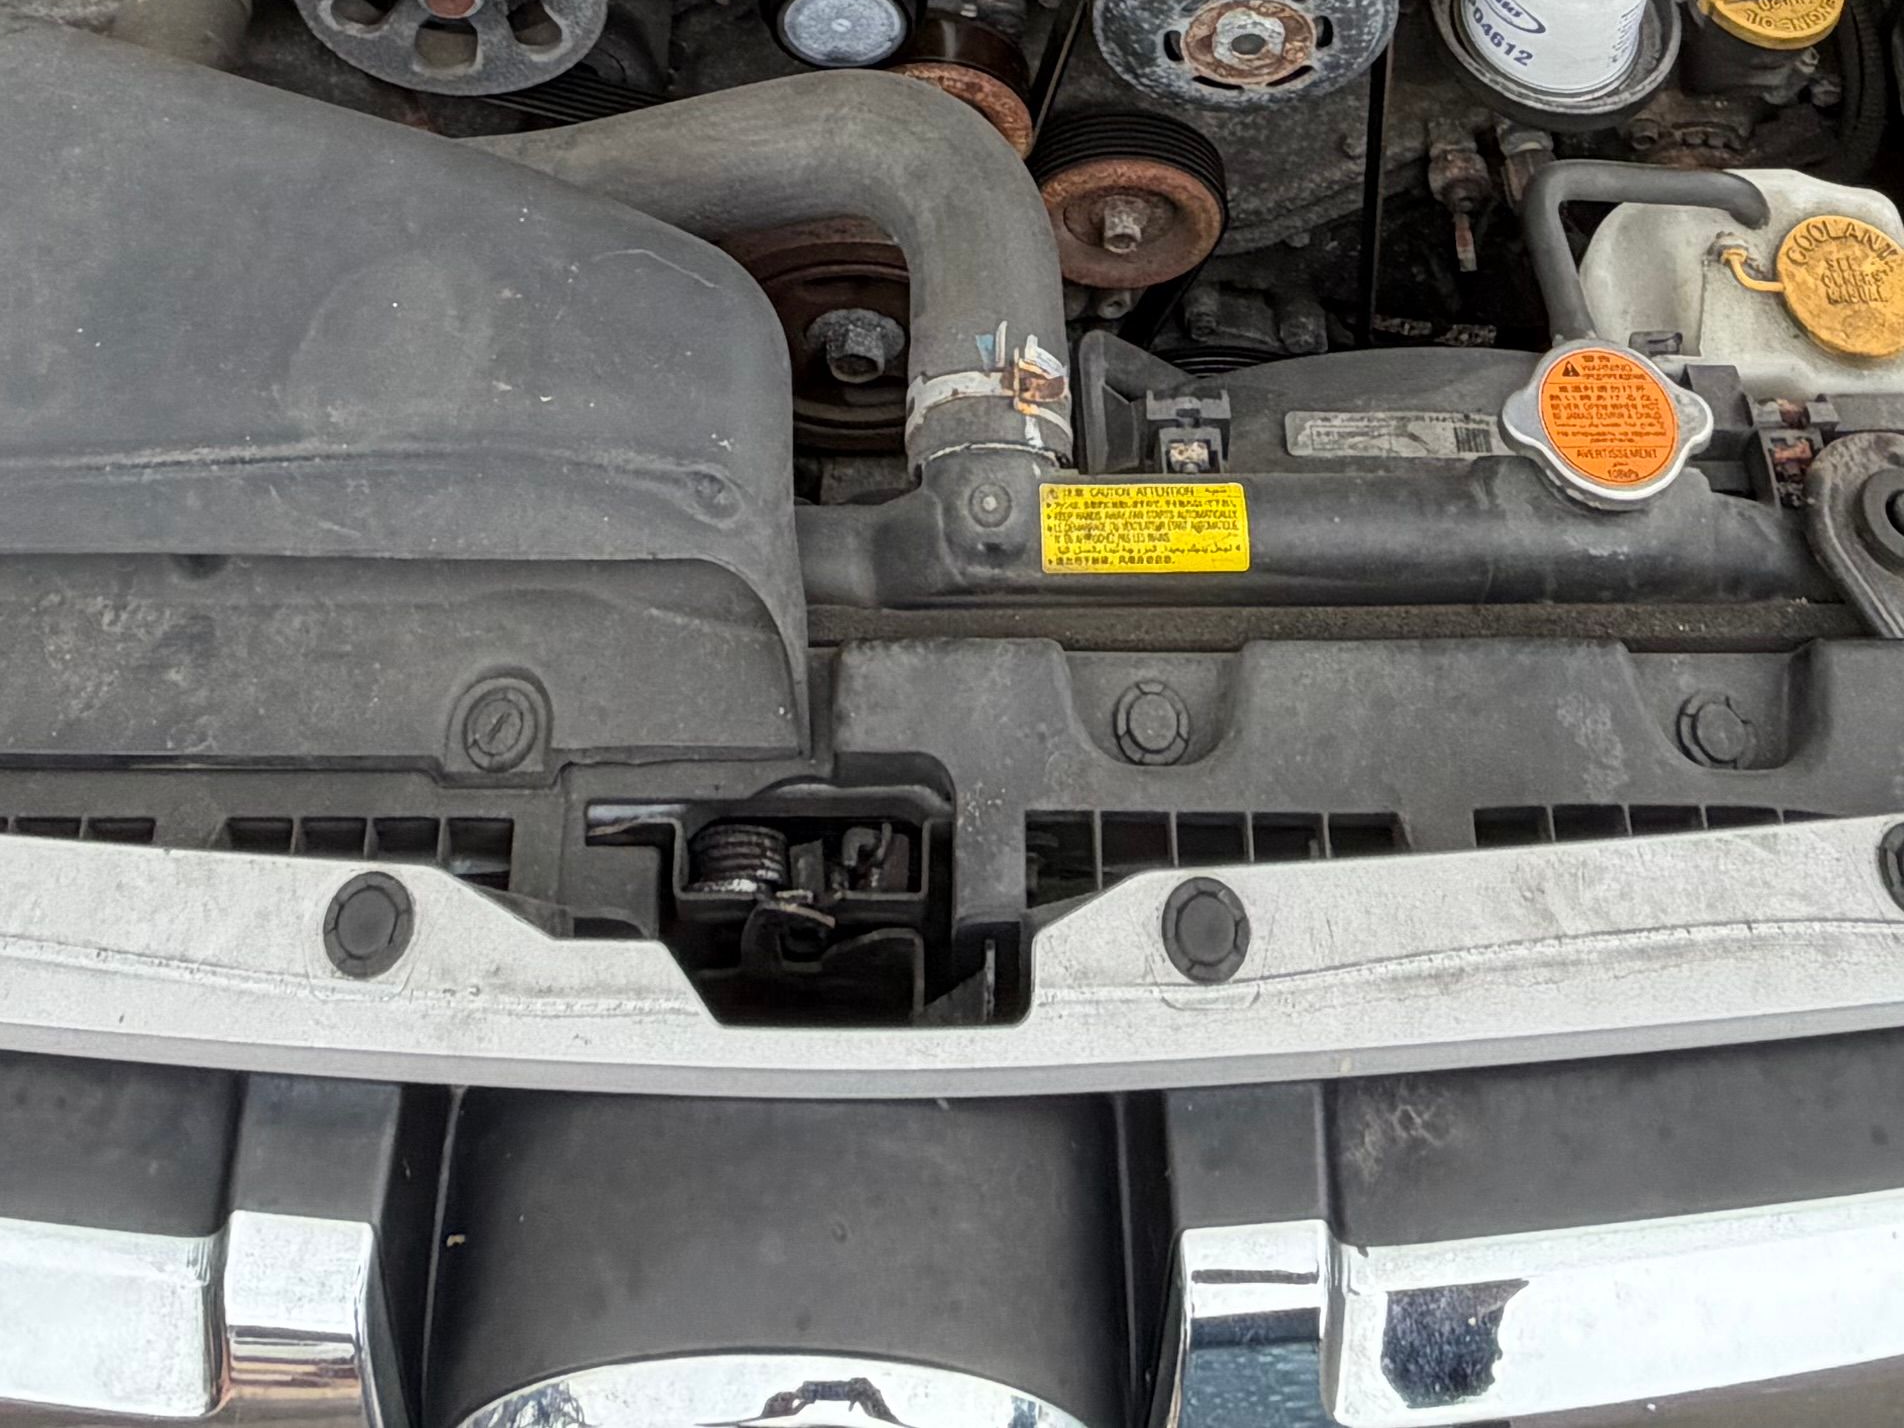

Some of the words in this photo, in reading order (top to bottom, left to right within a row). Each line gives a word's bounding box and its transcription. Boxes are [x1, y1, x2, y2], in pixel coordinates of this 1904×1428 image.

[1746, 8, 1776, 30] OIL
[1786, 220, 1899, 265] COOLANT
[1577, 448, 1658, 459] AVERTISSEMENT
[1089, 487, 1130, 498] CAUTION
[1136, 486, 1194, 497] ATTENTION
